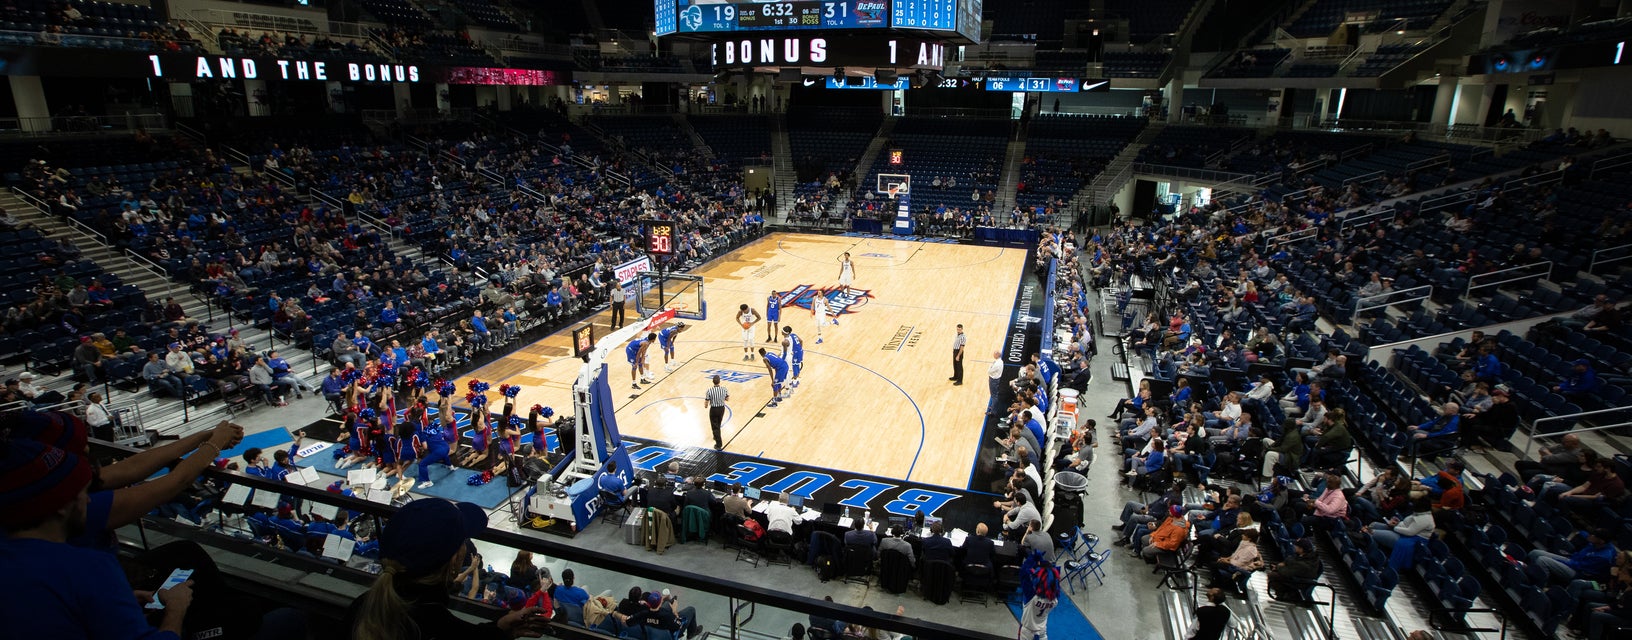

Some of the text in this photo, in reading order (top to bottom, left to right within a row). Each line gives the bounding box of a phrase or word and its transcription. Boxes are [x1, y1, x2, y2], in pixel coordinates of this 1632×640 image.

[713, 6, 735, 21] 19
[762, 3, 793, 16] 6:32
[824, 2, 847, 18] 31
[725, 38, 827, 64] BONUS
[888, 40, 897, 64] 1
[1613, 41, 1625, 65] 1
[149, 55, 419, 83] 1 AND THE BONUS
[975, 81, 980, 89] 1
[992, 82, 1004, 90] 06
[1018, 81, 1025, 90] 4
[1032, 80, 1045, 89] 31
[653, 226, 670, 236] 6:32
[652, 235, 669, 252] 30
[579, 337, 590, 351] 30
[1008, 333, 1026, 362] CHICAGO
[301, 441, 324, 457] BLUE
[705, 461, 963, 518] BLUE
